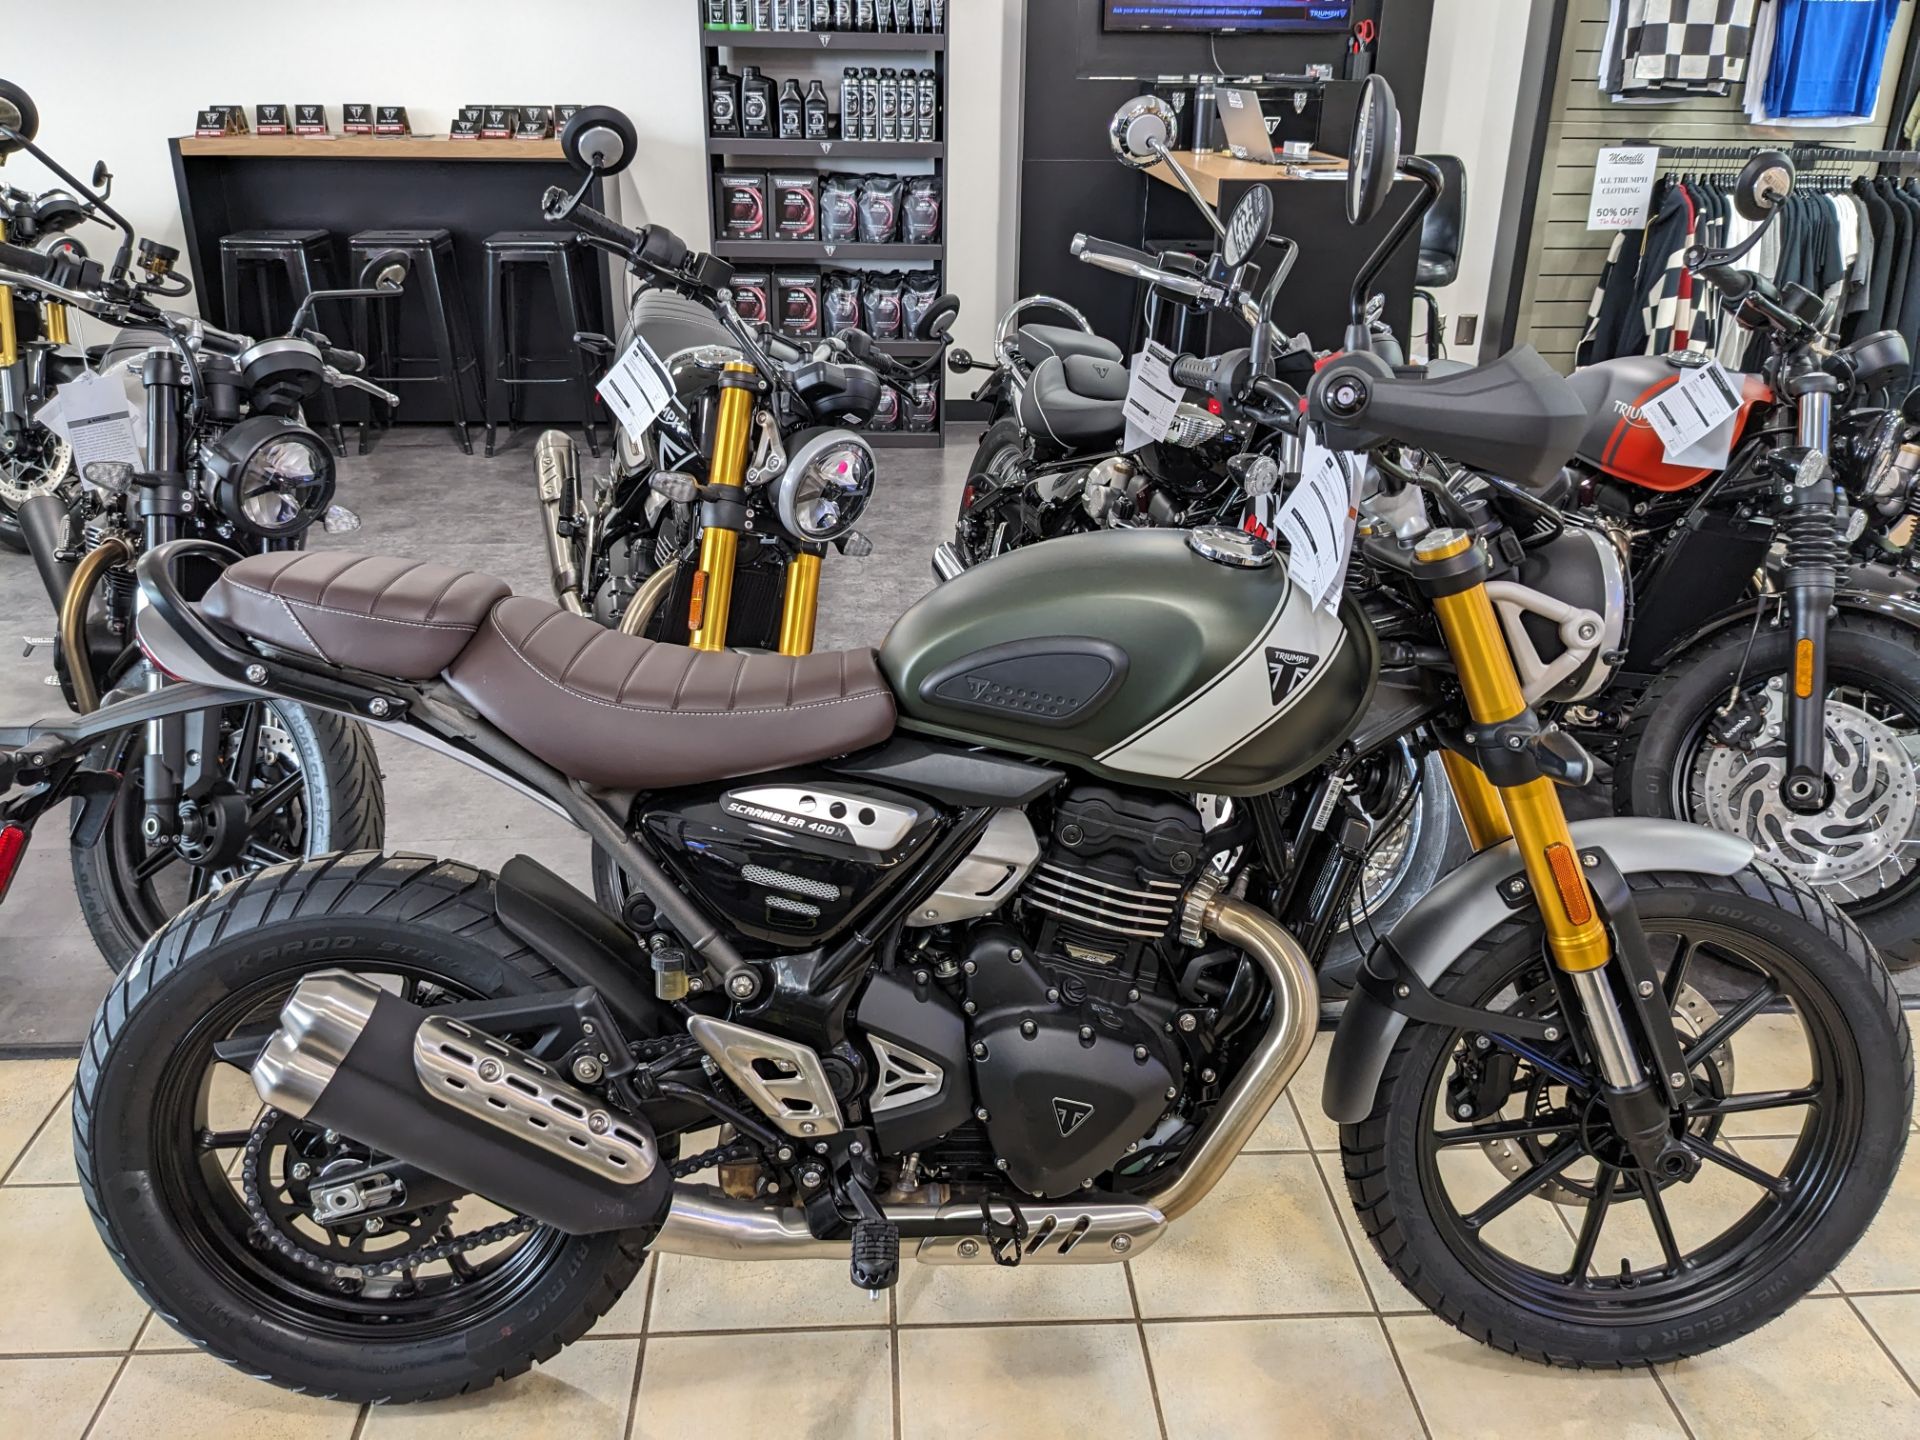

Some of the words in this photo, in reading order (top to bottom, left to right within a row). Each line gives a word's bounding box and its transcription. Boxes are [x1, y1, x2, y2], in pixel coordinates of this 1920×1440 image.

[1164, 8, 1177, 16] many
[1190, 8, 1203, 16] great
[1310, 9, 1340, 18] TRIUMPH
[1614, 176, 1648, 184] TRIUMPH
[1596, 208, 1617, 217] 50%
[1620, 207, 1640, 216] OFF
[1613, 400, 1648, 420] TRIU
[1275, 651, 1310, 664] TRIUMPH
[1722, 716, 1751, 739] brembo
[290, 714, 314, 758] ROAD
[310, 762, 325, 836] CLASSIC
[728, 802, 806, 828] SCRAMBLER
[1706, 904, 1782, 934] 100/90
